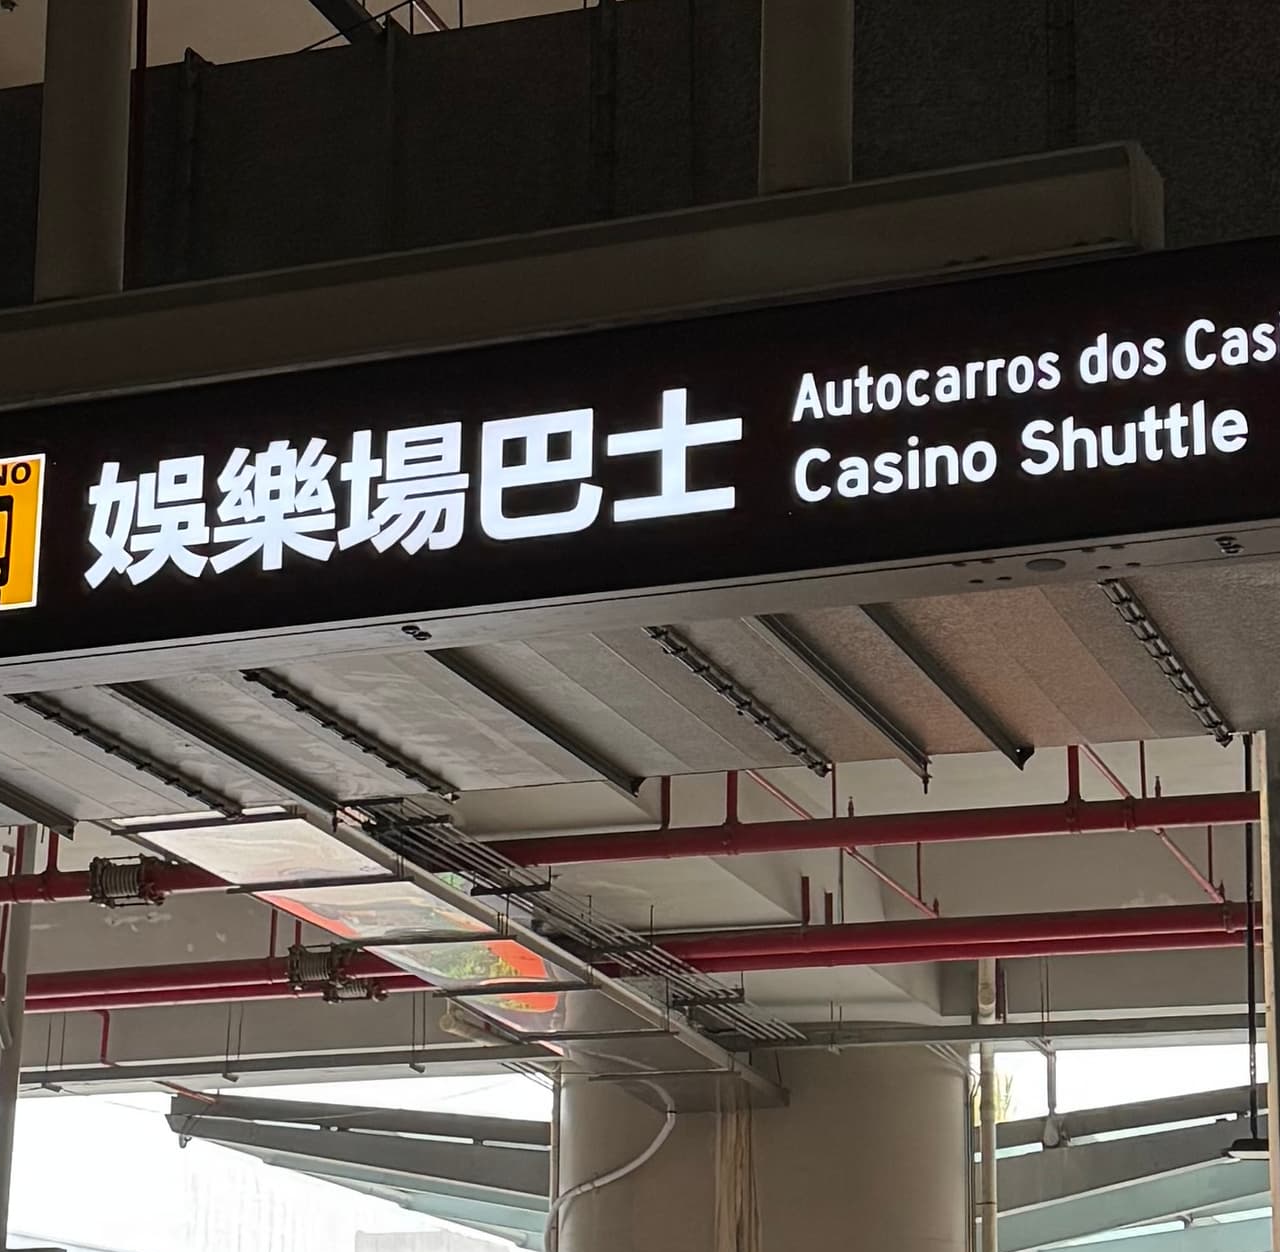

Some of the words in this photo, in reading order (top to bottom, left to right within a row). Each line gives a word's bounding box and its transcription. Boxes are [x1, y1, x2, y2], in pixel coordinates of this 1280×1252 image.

[792, 352, 1061, 422] Autocarros
[1080, 333, 1167, 384] dos
[85, 388, 744, 590] 娛樂場巴士
[795, 436, 997, 502] Casino
[1021, 400, 1249, 476] Shuttle
